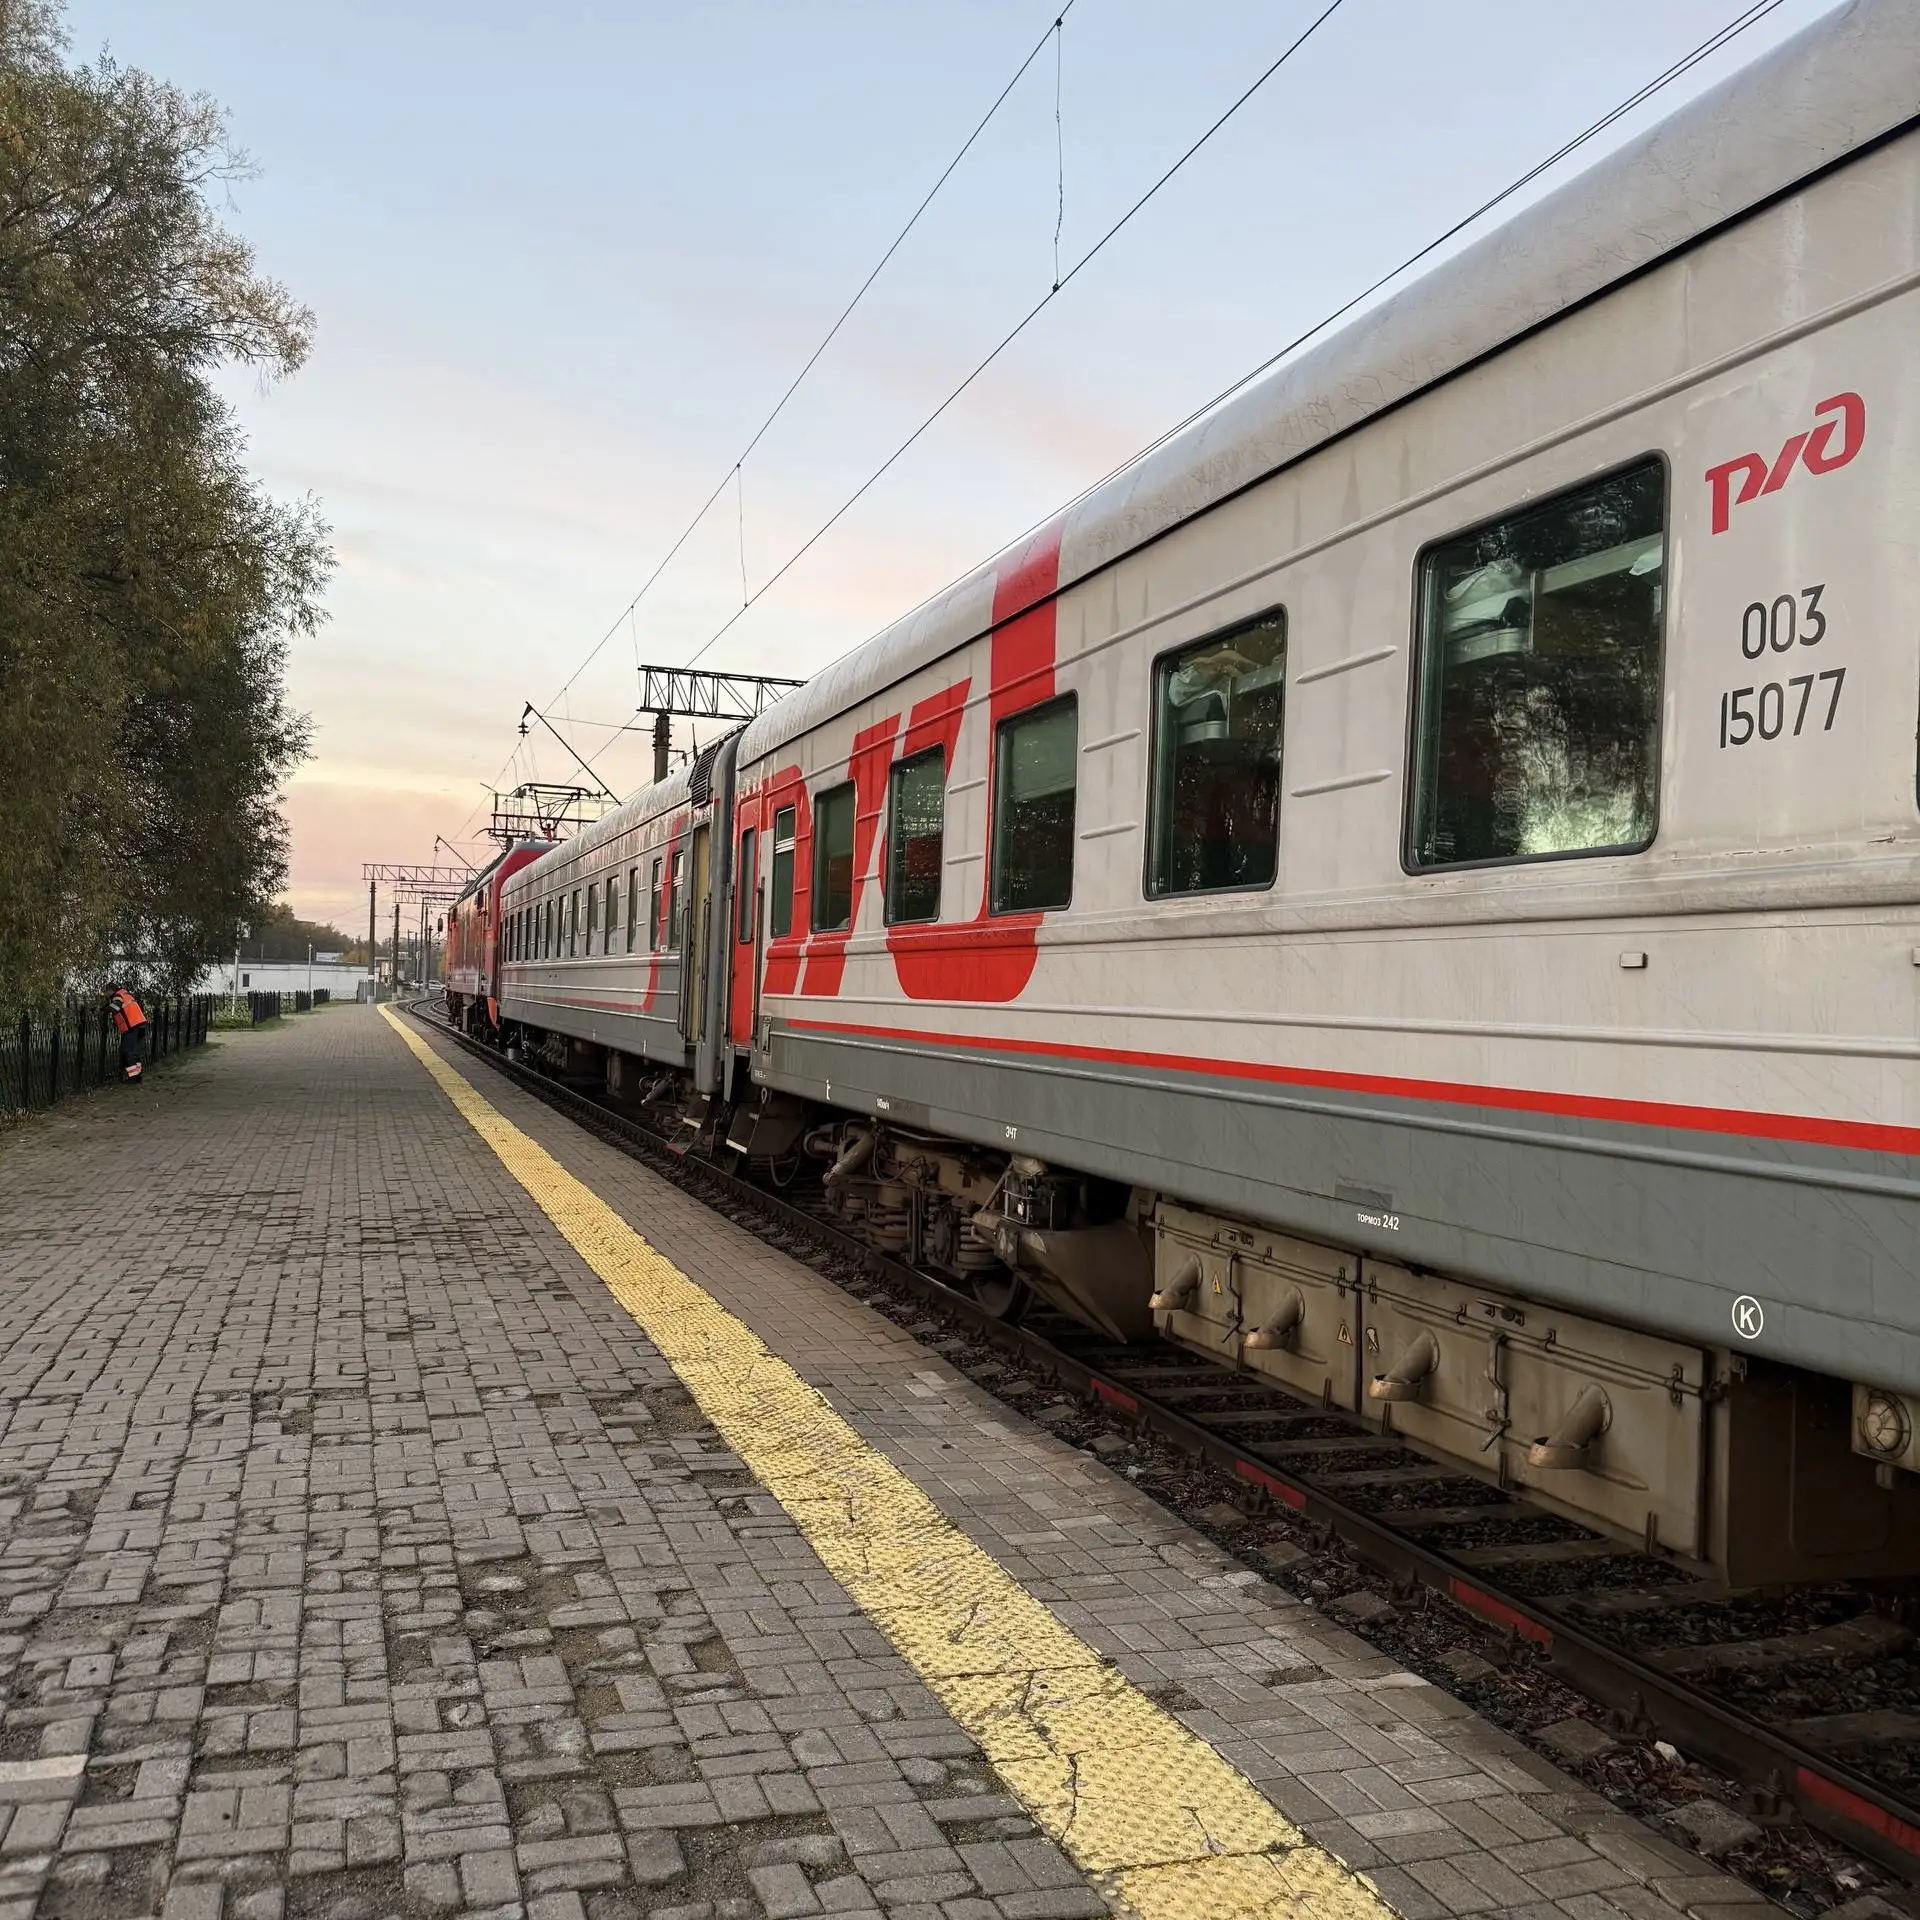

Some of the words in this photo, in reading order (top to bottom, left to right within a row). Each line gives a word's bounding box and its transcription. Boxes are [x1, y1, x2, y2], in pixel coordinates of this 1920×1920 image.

[1741, 583, 1827, 660] 003
[1719, 667, 1847, 749] 15077
[1357, 1213, 1381, 1226] ТОРМОЗ
[1382, 1214, 1399, 1230] 242
